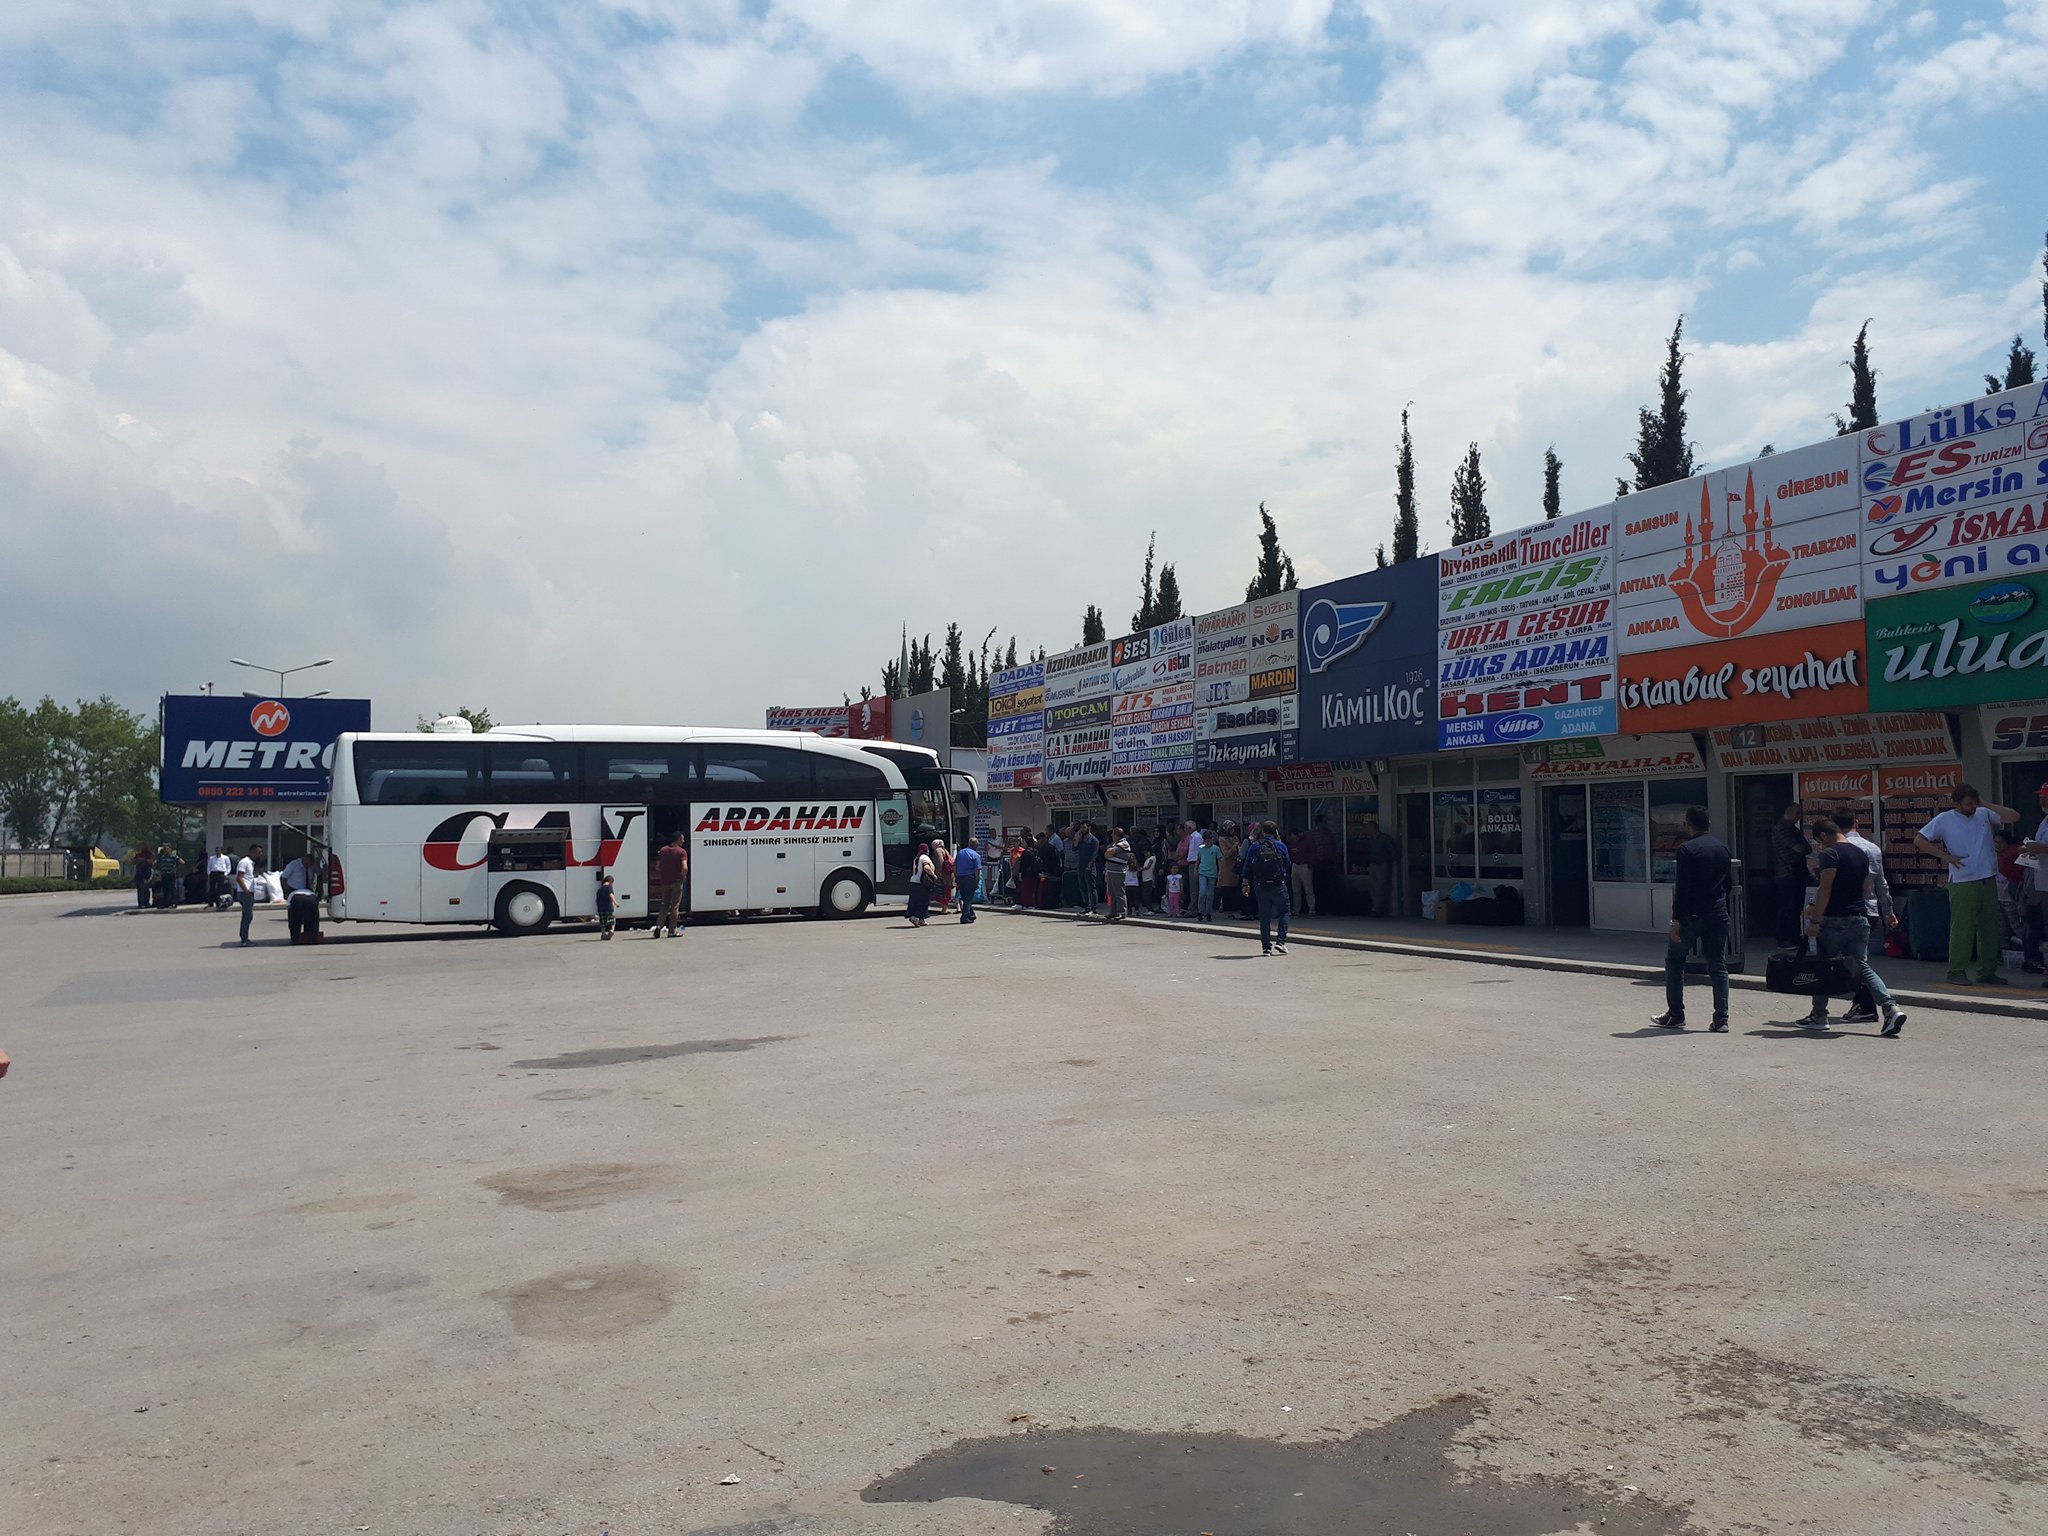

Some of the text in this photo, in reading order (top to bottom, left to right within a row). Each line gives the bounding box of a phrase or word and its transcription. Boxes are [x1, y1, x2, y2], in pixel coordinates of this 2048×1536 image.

[1896, 401, 2017, 453] Lüks
[1889, 440, 1977, 486] ES
[1777, 469, 1848, 500] GİRESUN
[1905, 467, 2023, 514] Mersin
[1624, 511, 1679, 537] SAMSUN
[1461, 540, 1494, 557] HAS
[1520, 520, 1611, 566] Tunceliler
[1792, 533, 1857, 560] TRABZON
[1874, 545, 1987, 590] yeni
[1618, 573, 1667, 595] ANTALYA
[1479, 606, 1497, 616] PATNOS
[1519, 599, 1539, 610] TATVAN
[1542, 594, 1559, 604] AHLAT
[1577, 586, 1594, 597] CEVAZ
[1599, 583, 1611, 592] VAN
[1776, 584, 1858, 611] ZONGULDAK
[1160, 622, 1192, 645] Gülen
[1447, 619, 1509, 650] URFA
[1517, 599, 1610, 637] CESUR
[1627, 616, 1680, 638] ANKARA
[1123, 638, 1148, 660] SES
[1440, 635, 1609, 682] LÜKS ADANA
[1455, 647, 1478, 656] ADANA
[998, 663, 1044, 684] DADAŞ
[1198, 658, 1247, 678] Batman
[1405, 667, 1424, 685] 1926
[1441, 680, 1469, 689] AKSARAY
[1474, 675, 1495, 684] ADANA
[1501, 670, 1528, 679] CEYHAN
[1585, 656, 1610, 667] HATAY
[1742, 650, 1862, 698] seyahat
[1116, 691, 1155, 713] ATS
[1440, 674, 1611, 718] KENT
[769, 709, 803, 718] KARS
[1054, 701, 1109, 720] TOPÇAM
[1216, 705, 1280, 730] Esadaş
[769, 717, 832, 727] HUZUR
[995, 720, 1019, 734] JET
[1151, 730, 1193, 745] URFA HASSOY
[1446, 722, 1597, 746] ANKARA ADANA
[1738, 729, 1756, 746] 12
[1208, 738, 1277, 765] Özkaymak
[1531, 745, 1542, 761] 11
[1748, 748, 1784, 765] ANKARA
[1884, 736, 1948, 757] ZONGULDAK
[1133, 762, 1151, 774] KARS
[1374, 760, 1384, 772] 10
[1532, 751, 1695, 775] ALANYALILAR
[226, 786, 244, 796] 222
[247, 787, 259, 796] 34
[262, 787, 275, 796] 55
[1274, 779, 1335, 792] Batman
[1884, 770, 1957, 793] seyahat
[235, 809, 266, 818] METRO
[694, 805, 867, 832] ARDAHAN
[1487, 814, 1514, 823] BOLU
[1480, 823, 1521, 833] ANKARA
[750, 837, 781, 846] SINIRA
